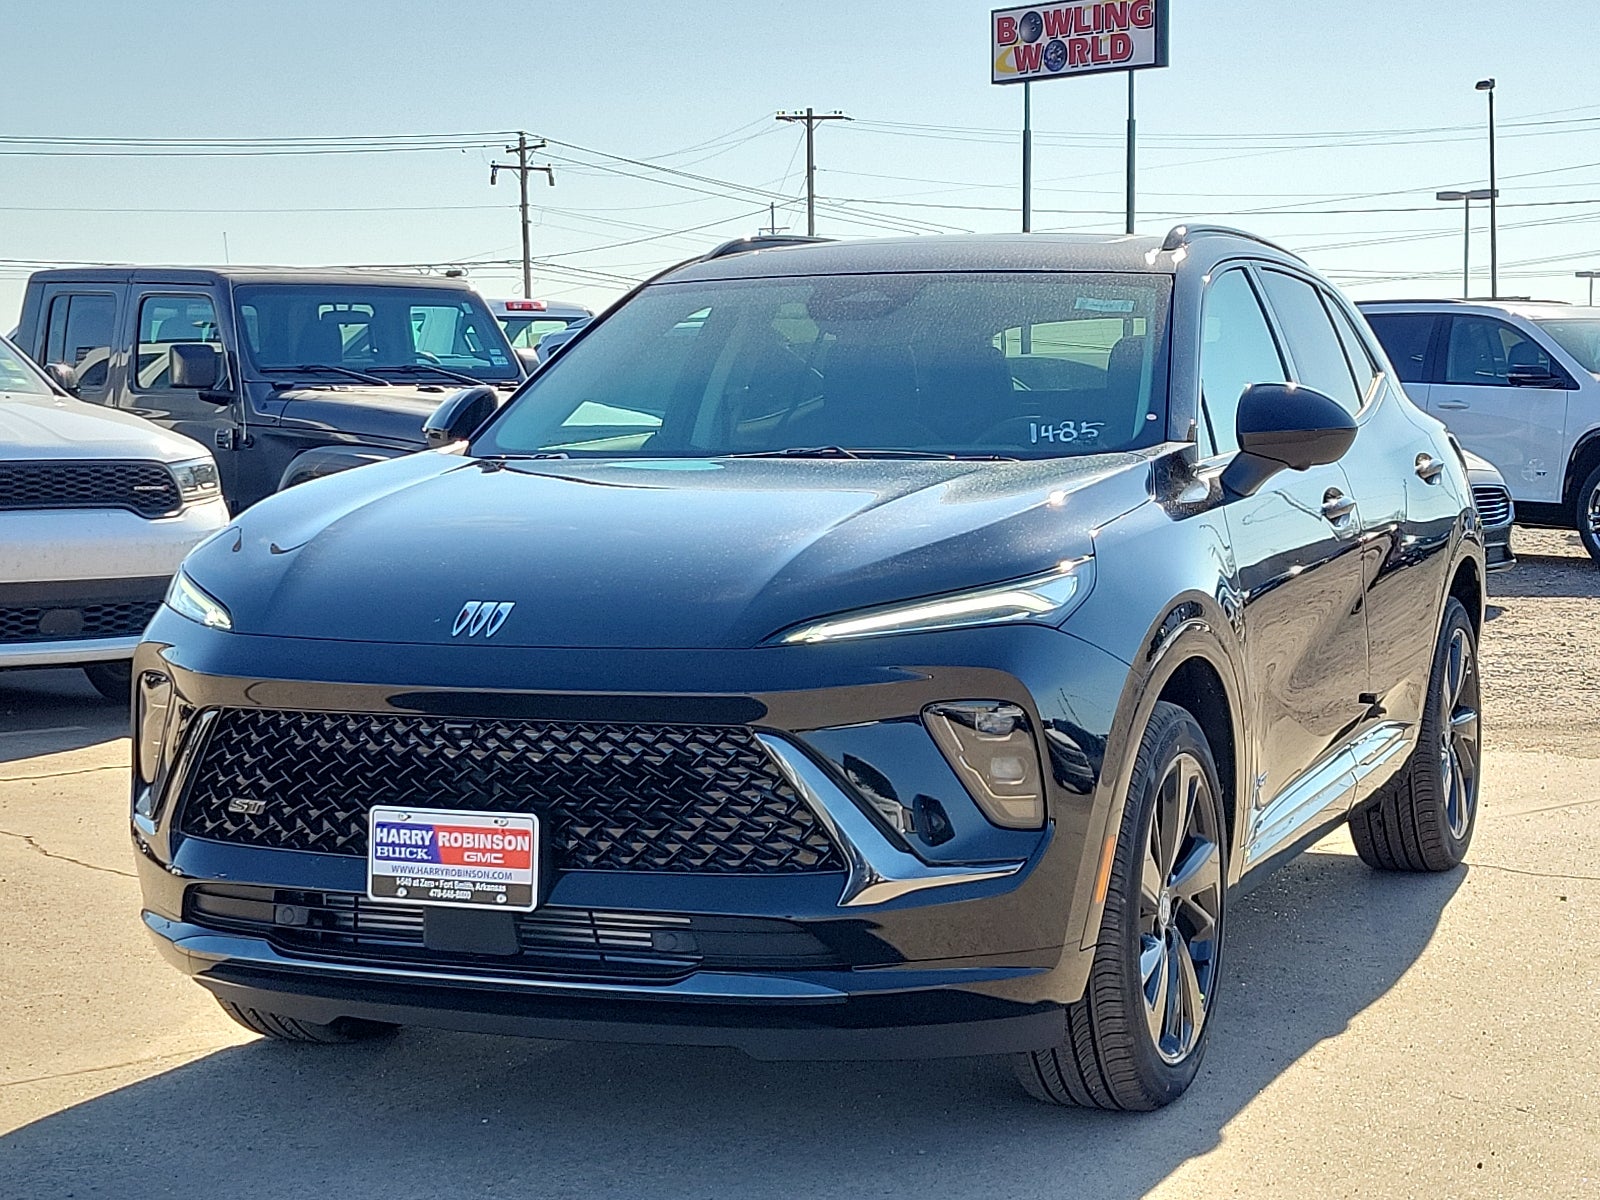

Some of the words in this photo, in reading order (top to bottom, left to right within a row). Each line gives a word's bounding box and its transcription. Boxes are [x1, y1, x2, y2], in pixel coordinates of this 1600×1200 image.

[997, 0, 1152, 44] BOWLING
[1013, 33, 1132, 72] WORLD
[1030, 421, 1104, 443] 1485
[376, 827, 434, 846] HARRY
[438, 831, 529, 852] ROBINSON
[463, 851, 505, 864] GMC
[391, 864, 513, 880] WWW.HARRYROBINSON.COM
